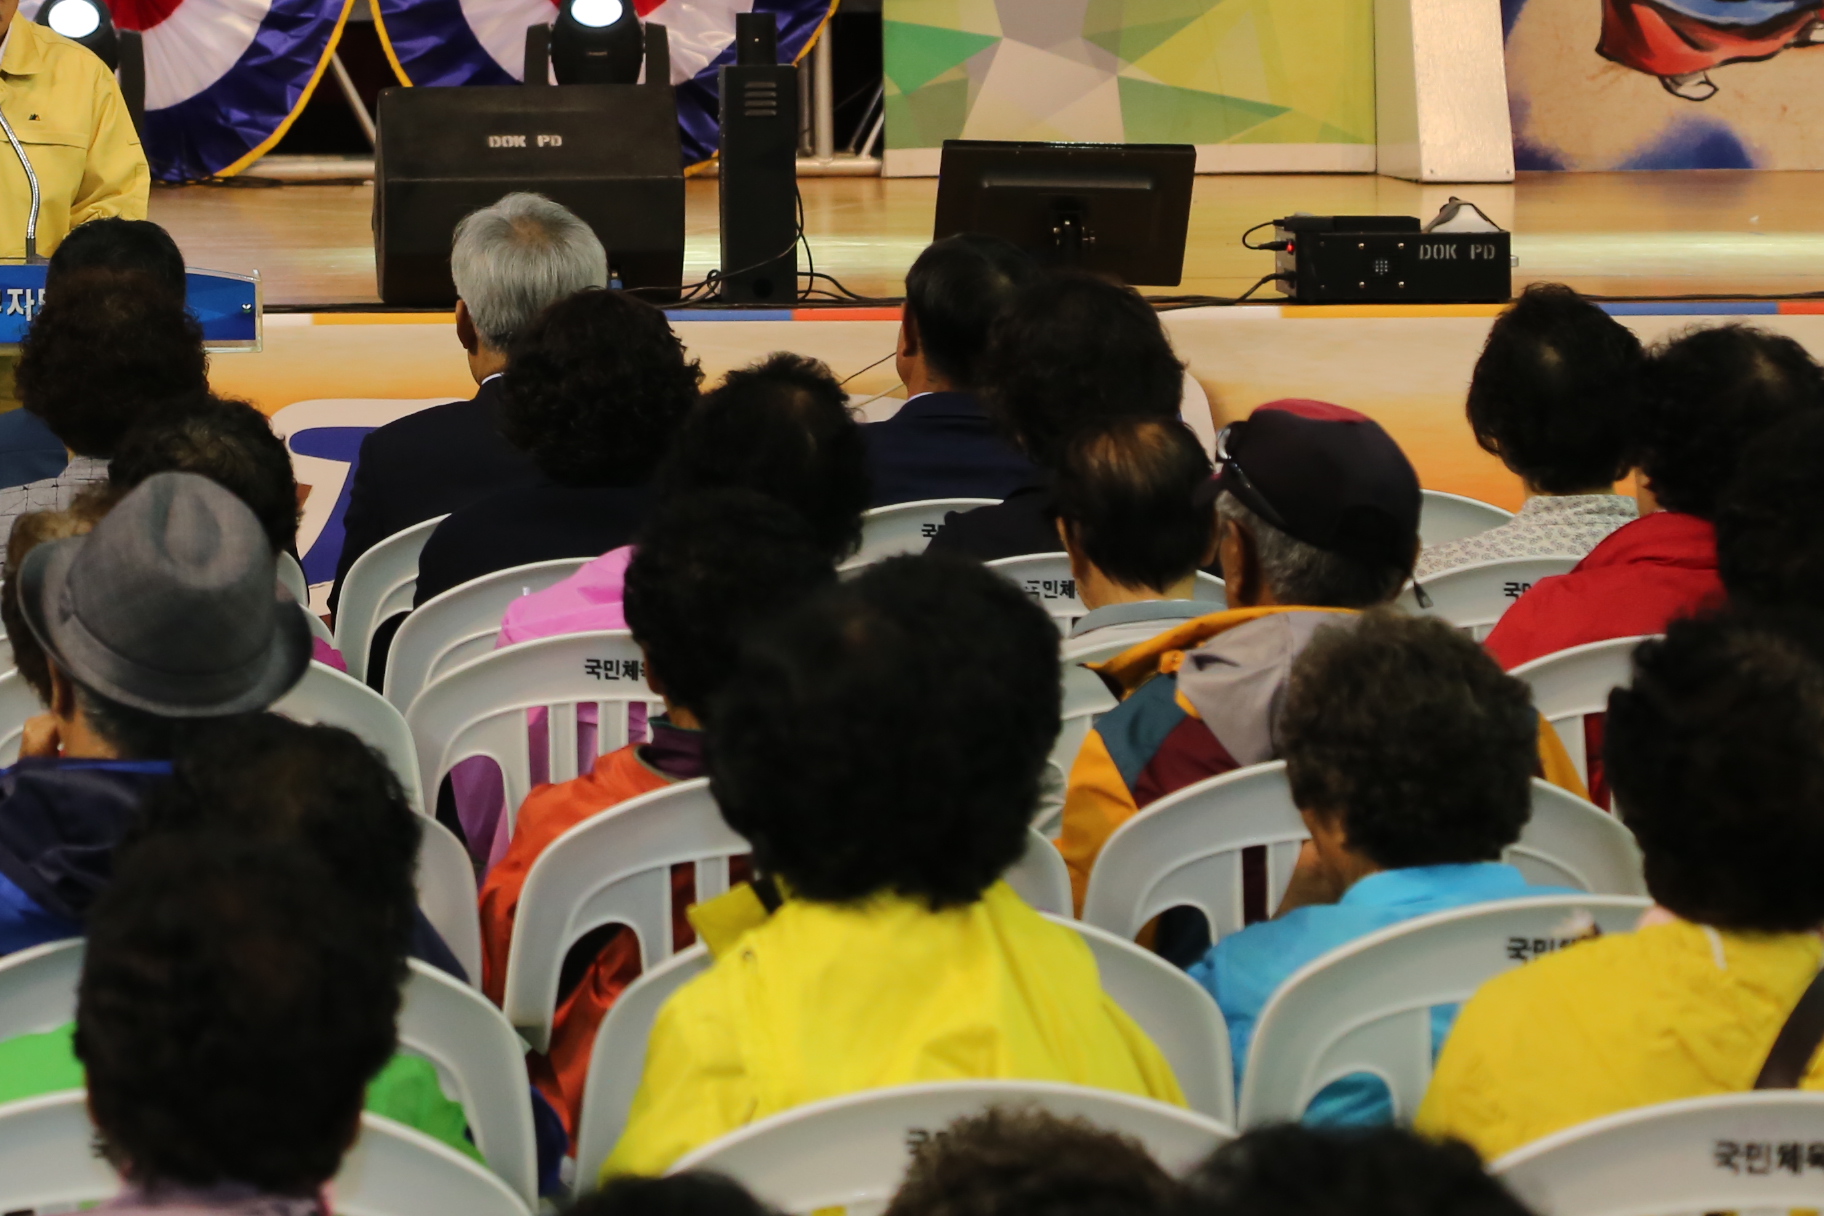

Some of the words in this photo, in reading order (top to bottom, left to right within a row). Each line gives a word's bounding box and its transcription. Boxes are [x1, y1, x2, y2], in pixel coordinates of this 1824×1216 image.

[488, 135, 526, 148] DOK
[537, 135, 563, 148] PD
[1419, 244, 1457, 260] DOK
[1470, 244, 1496, 260] PD
